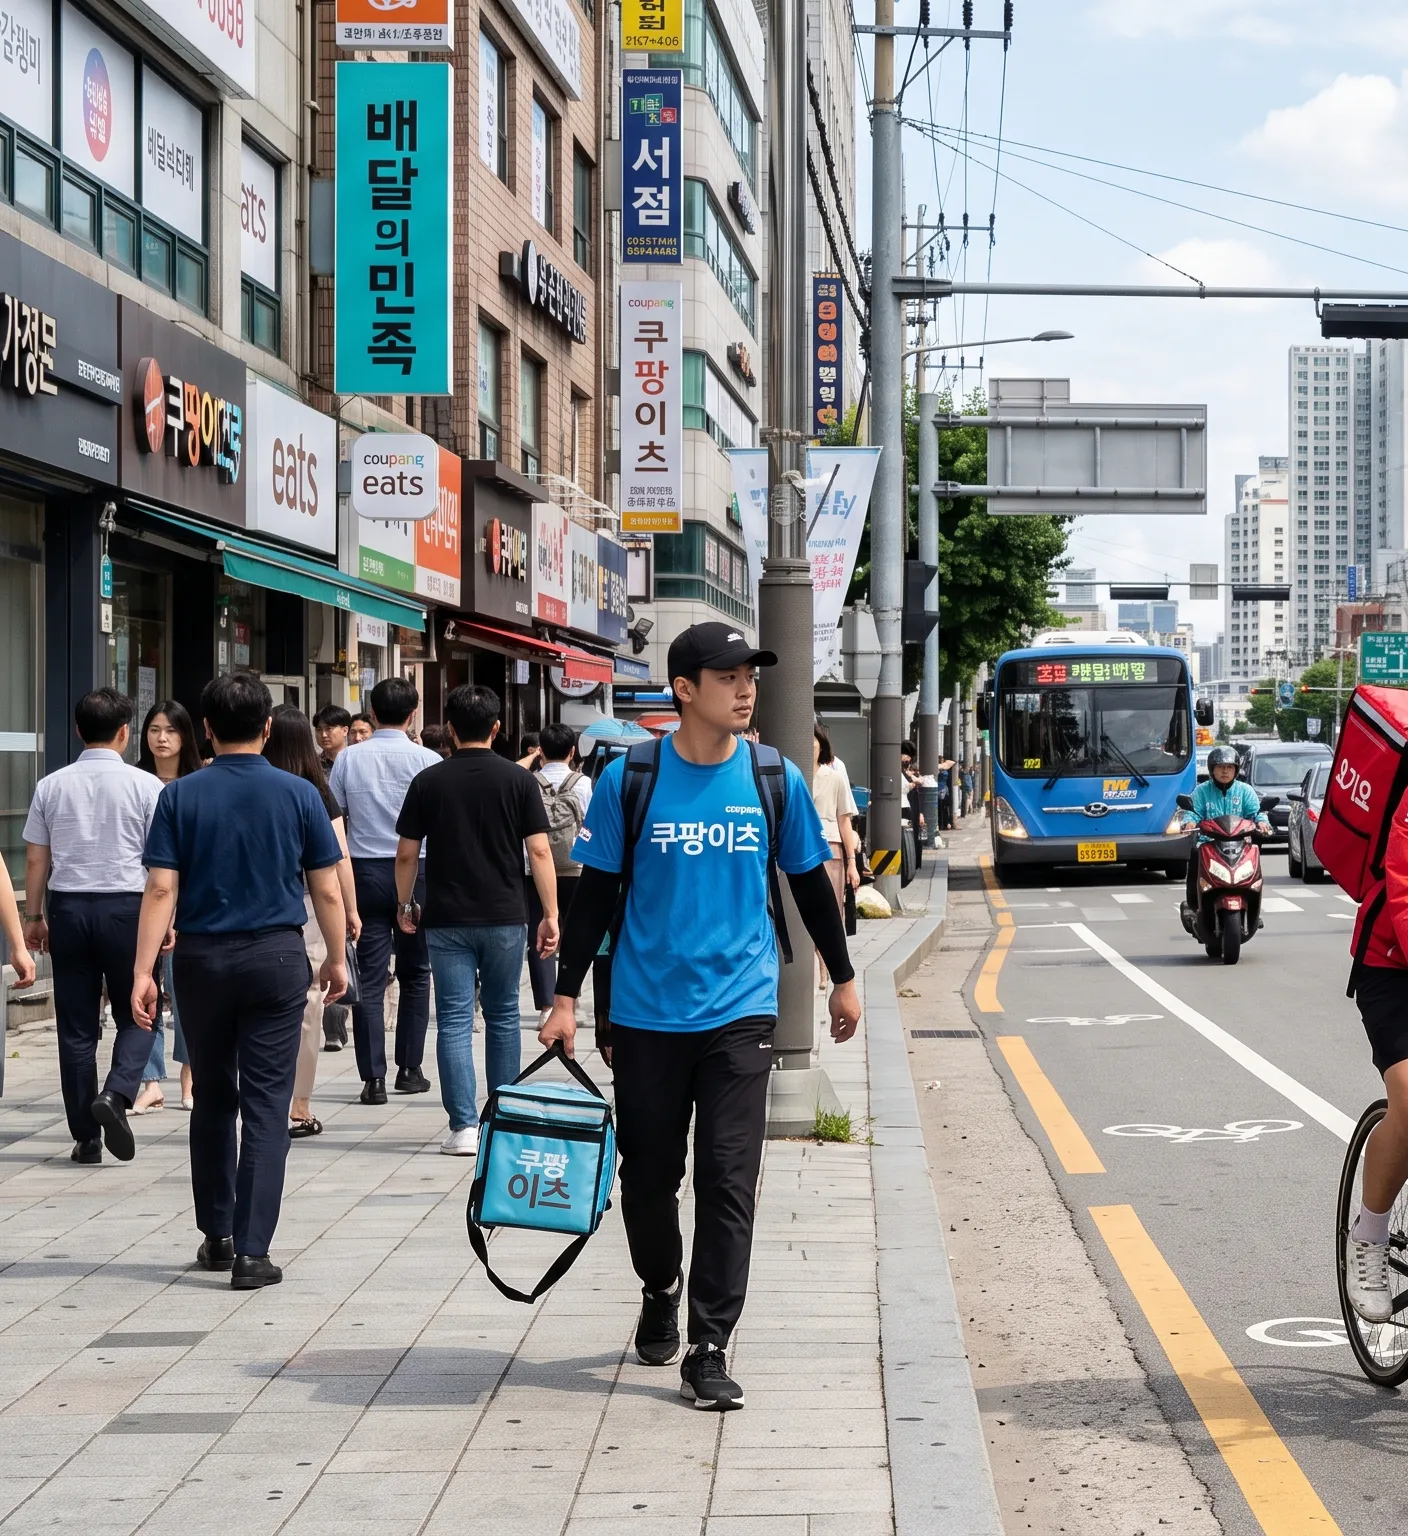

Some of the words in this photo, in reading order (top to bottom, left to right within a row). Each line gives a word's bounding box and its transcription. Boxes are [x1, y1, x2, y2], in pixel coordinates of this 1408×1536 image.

[632, 137, 670, 226] 서점
[367, 100, 418, 375] 배달의민족
[634, 321, 669, 472] 쿠팡이츠
[272, 433, 319, 517] eats
[363, 471, 424, 496] eats
[364, 454, 425, 468] coupang
[650, 821, 760, 856] 쿠팡이츠
[508, 1173, 571, 1210] 이츠
